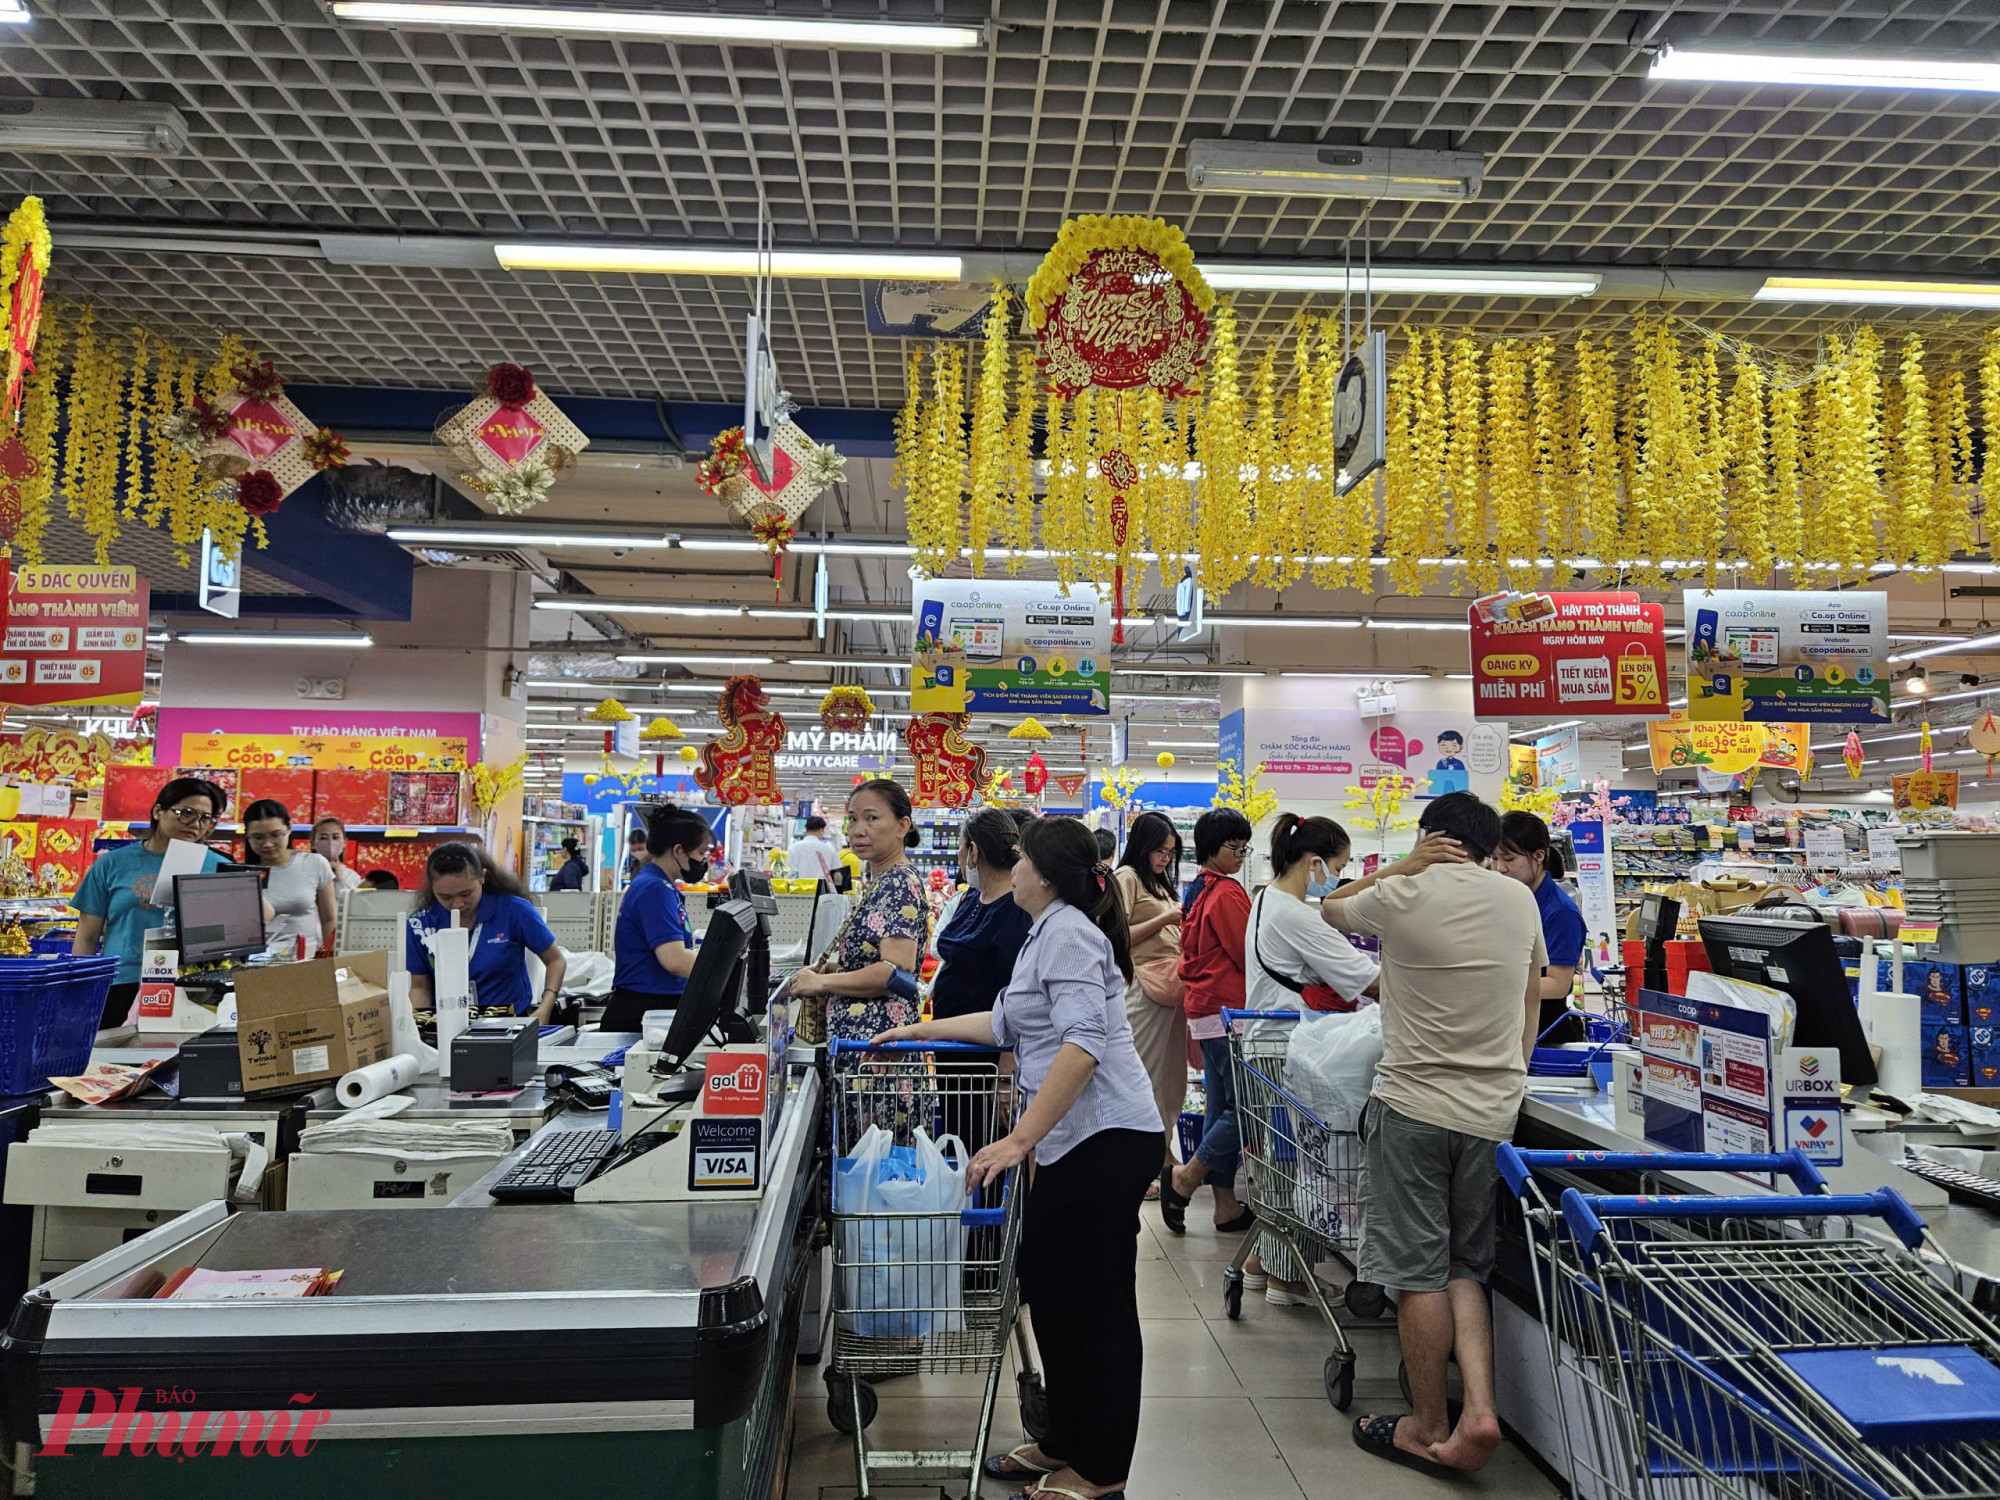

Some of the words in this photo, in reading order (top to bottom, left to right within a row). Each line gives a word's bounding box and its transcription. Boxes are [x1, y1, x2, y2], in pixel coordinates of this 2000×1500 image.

[1104, 251, 1147, 262] HAPPY
[27, 573, 36, 588] 5
[77, 569, 130, 588] QUYỀN
[9, 599, 39, 616] ÀNG
[42, 599, 98, 617] THÀNH
[101, 599, 139, 617] VIÊN
[1561, 605, 1581, 616] HÃY
[1583, 602, 1605, 616] TRỞ
[1607, 603, 1641, 616] THÀNH
[1811, 612, 1835, 620] Co.op
[1838, 612, 1866, 620] Online
[1493, 620, 1537, 635] KHÁCH
[1540, 619, 1576, 633] HÀNG
[1579, 617, 1622, 633] THÀNH
[1624, 619, 1654, 634] VIÊN
[52, 634, 63, 643] 02
[125, 634, 137, 643] 03
[1033, 639, 1091, 649] cooponline.vn
[1542, 637, 1565, 645] NGAY
[1567, 636, 1586, 645] HÔM
[1588, 636, 1605, 645] NAY
[1810, 647, 1868, 655] cooponline.vn
[1487, 657, 1517, 671] ĐĂNG
[1519, 657, 1533, 670] KÝ
[1621, 663, 1635, 673] LÊN
[1637, 662, 1652, 673] ĐẾN
[8, 667, 21, 675] 04
[82, 667, 95, 675] 05
[1560, 665, 1581, 679] TIẾT
[1584, 667, 1609, 680] KIỆM
[1480, 679, 1517, 699] MIỄN
[1521, 681, 1546, 699] PHÍ
[1561, 684, 1584, 694] MUA
[1587, 681, 1610, 694] SẮM
[1622, 674, 1657, 701] 5%
[312, 724, 339, 736] HÀO
[342, 725, 376, 737] HÀNG
[379, 726, 406, 737] VIỆT
[410, 729, 437, 737] NAM
[1694, 724, 1716, 733] Khai
[787, 726, 825, 751] MỸ
[829, 722, 897, 752] PHẨM
[1696, 736, 1714, 748] đắc
[1739, 734, 1750, 744] cả
[1284, 742, 1300, 750] SÓC
[1301, 742, 1327, 750] KHÁCH
[1737, 744, 1756, 754] năm
[824, 755, 859, 767] CARE
[53, 836, 68, 845] An
[1971, 970, 1984, 983] DC
[1976, 1031, 1989, 1044] DC
[248, 1055, 277, 1064] Twinkle
[712, 1074, 736, 1090] got
[744, 1075, 753, 1088] it
[1785, 1080, 1834, 1092] URBOX
[697, 1124, 756, 1137] Welcome
[1795, 1140, 1826, 1149] VNPAY
[703, 1158, 748, 1174] VISA
